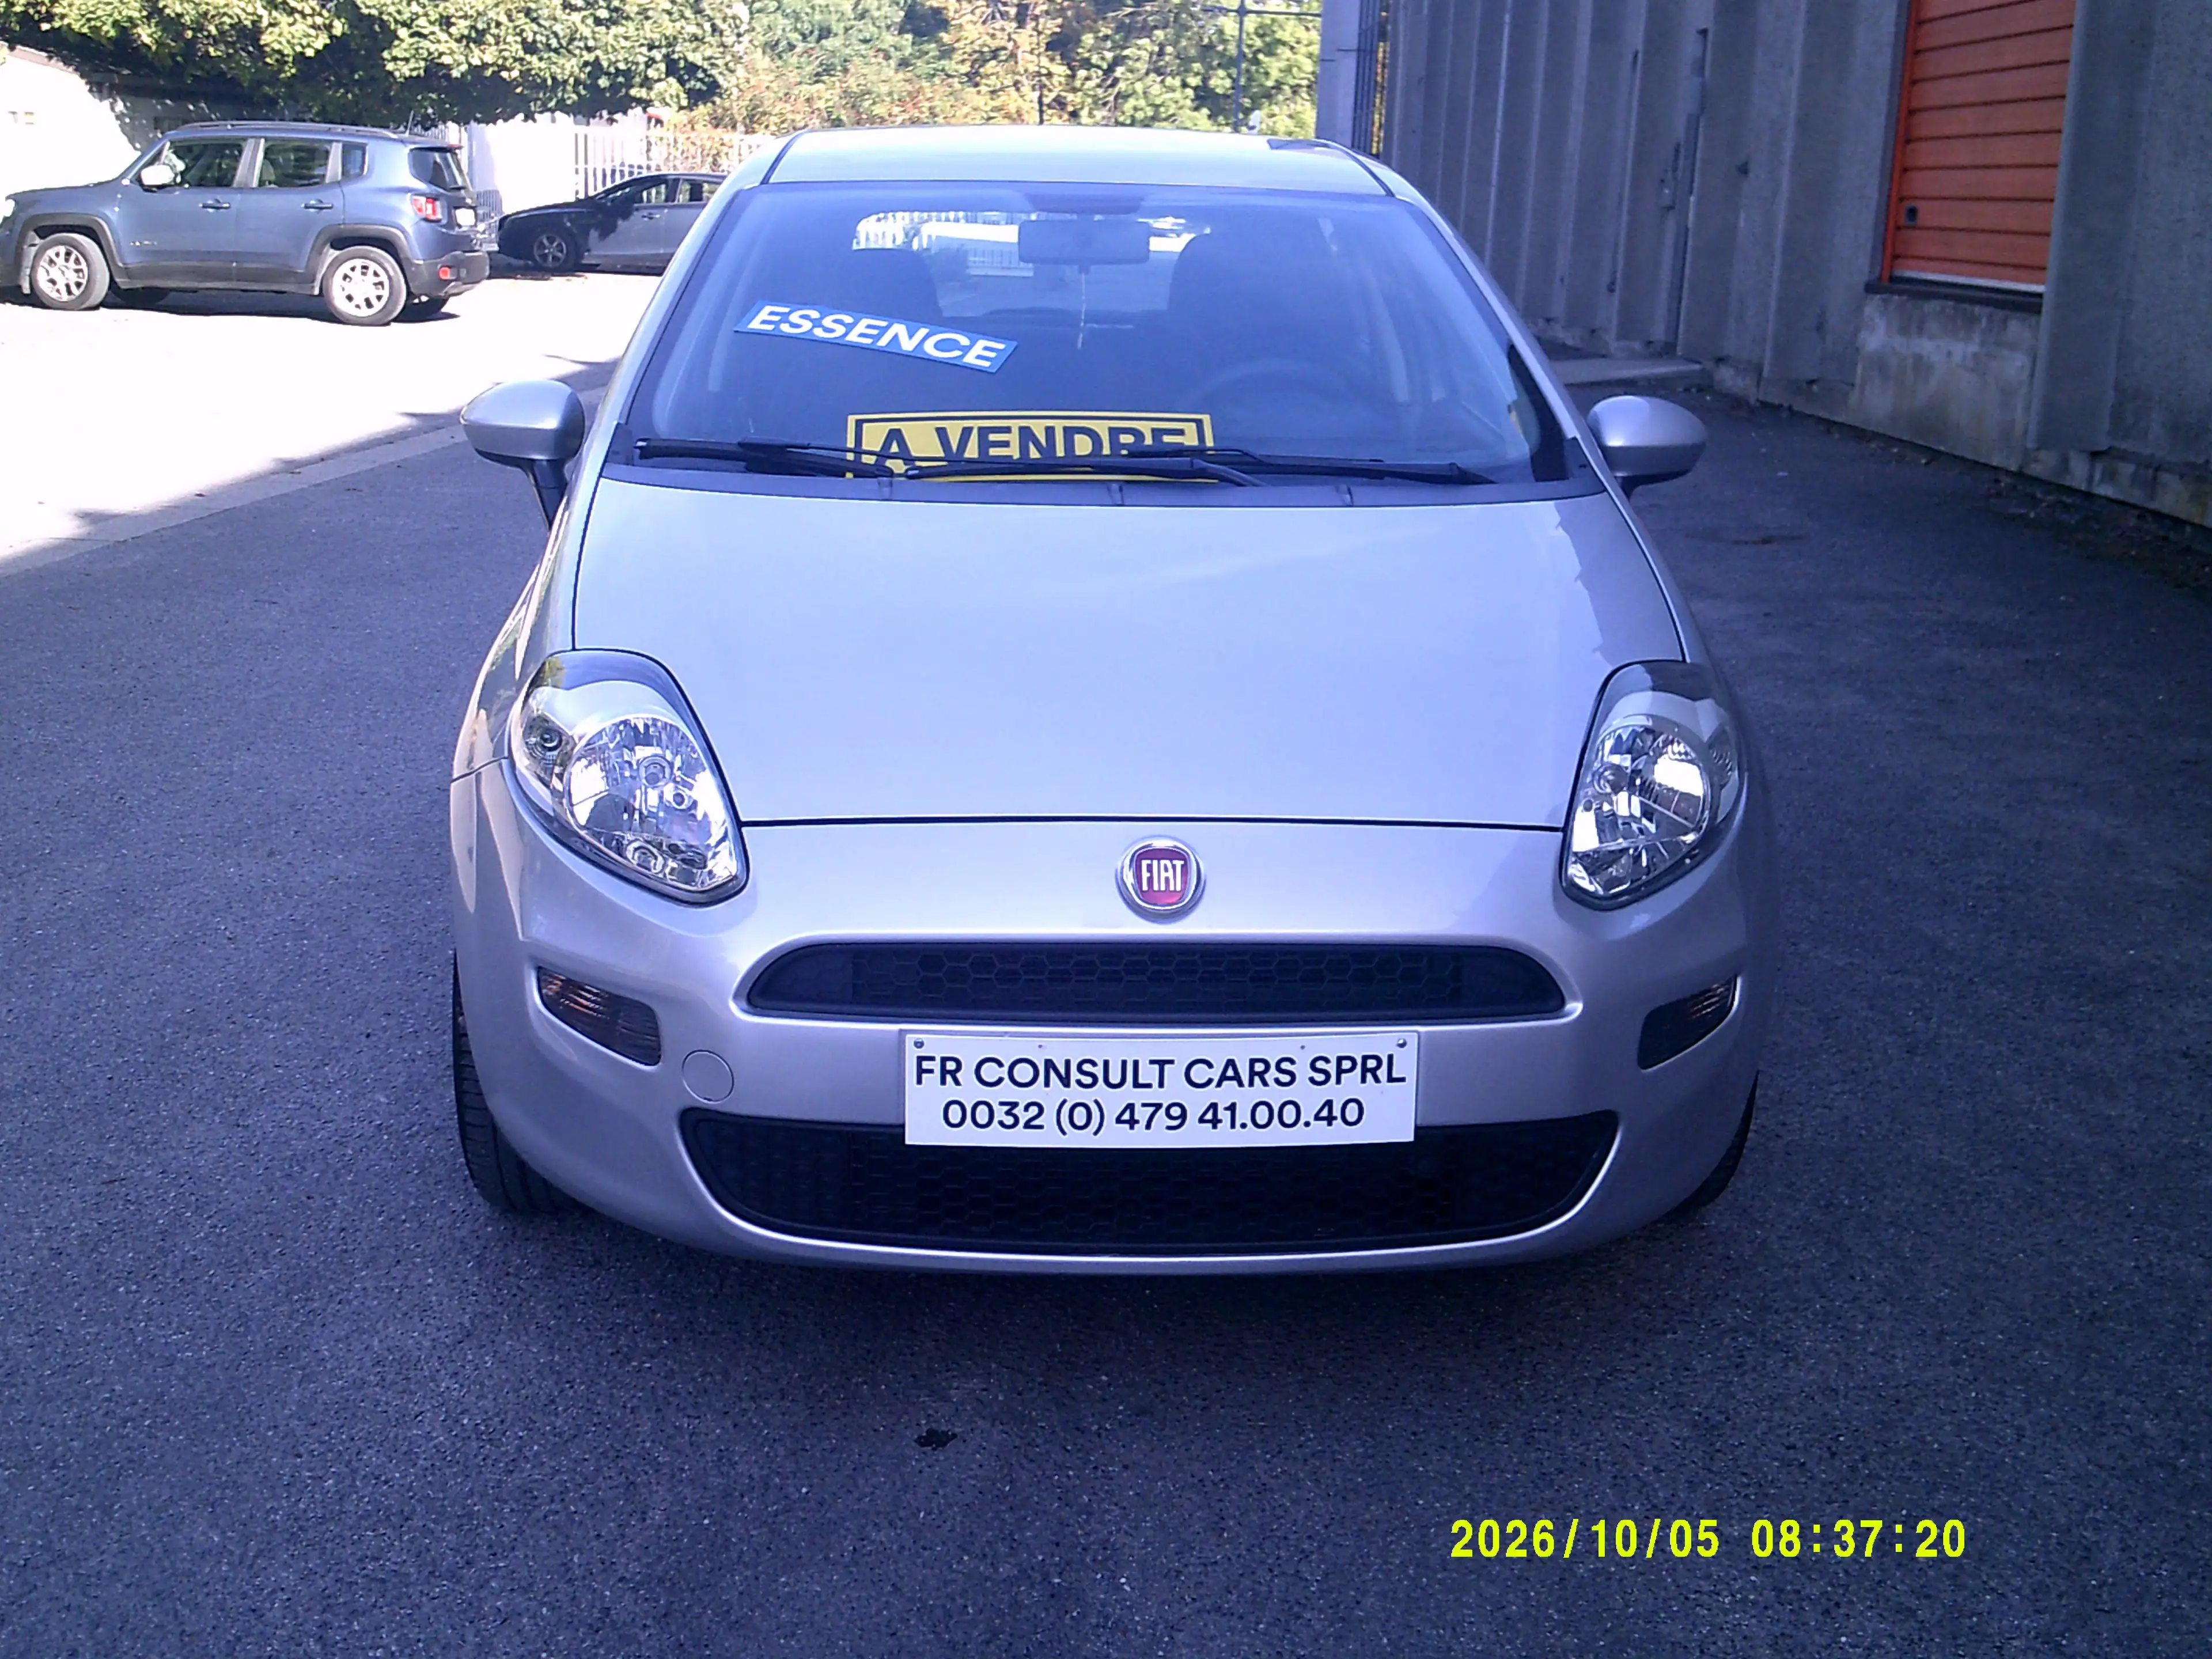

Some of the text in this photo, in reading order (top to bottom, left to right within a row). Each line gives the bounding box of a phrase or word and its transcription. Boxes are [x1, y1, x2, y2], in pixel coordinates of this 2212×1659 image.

[747, 305, 1006, 368] ESSENCE
[874, 427, 917, 464] A
[1141, 859, 1184, 891] FIAT
[915, 1053, 1406, 1089] FR CONSULT CARS SPRL
[943, 1098, 1365, 1137] 0032 (0) 479 41.00.40
